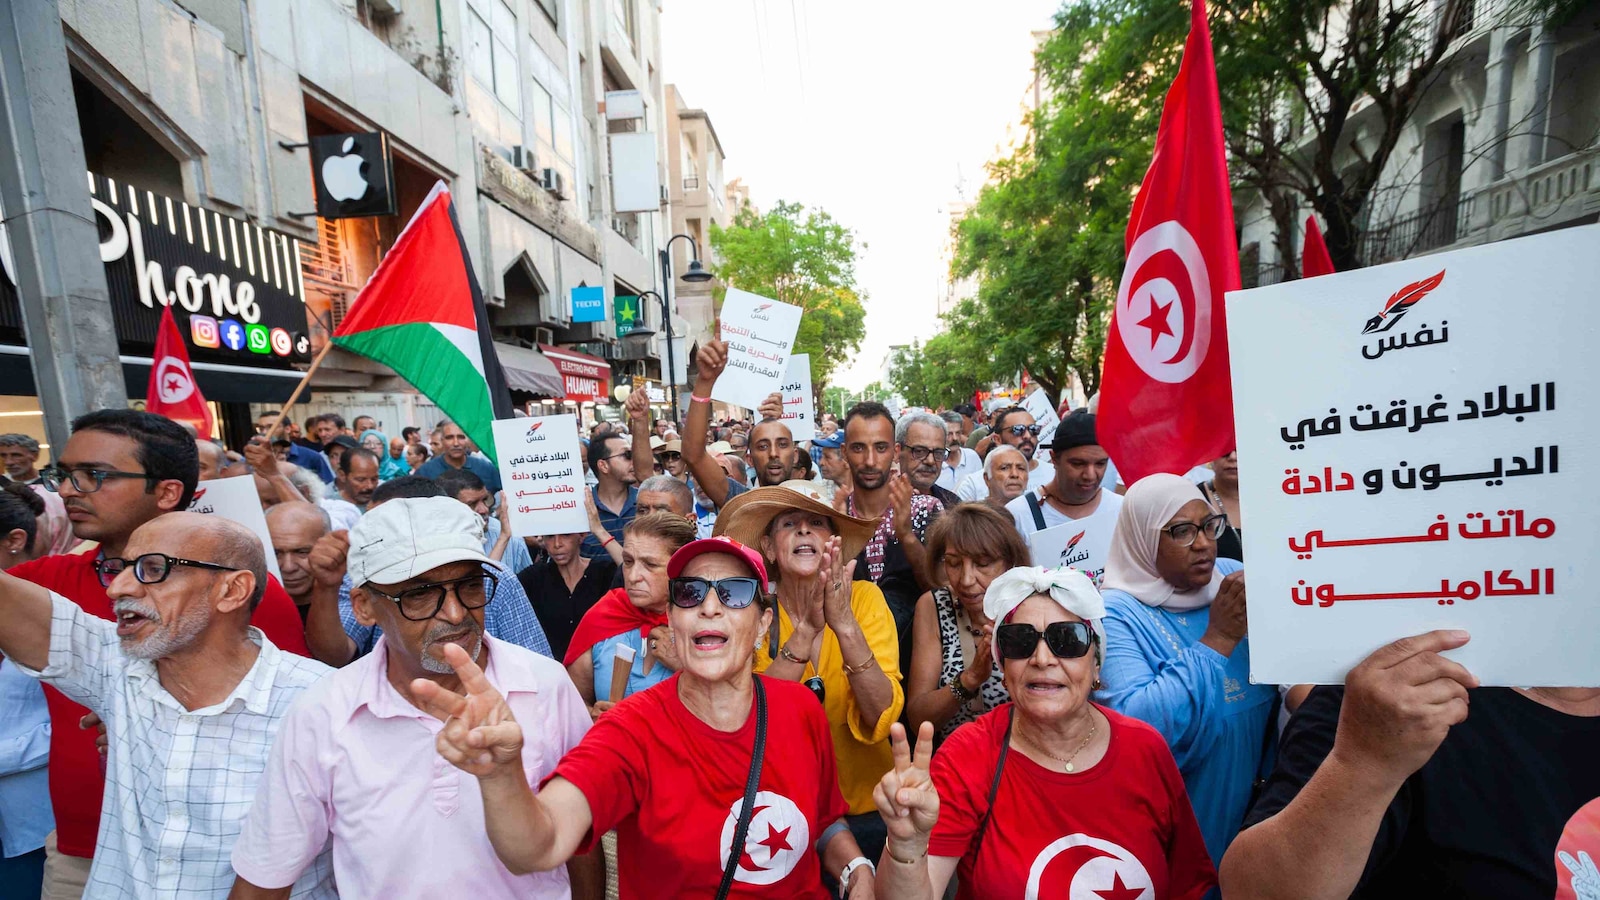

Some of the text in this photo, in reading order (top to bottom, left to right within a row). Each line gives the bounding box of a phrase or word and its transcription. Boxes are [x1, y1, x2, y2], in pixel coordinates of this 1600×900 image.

[574, 299, 601, 308] TECNO
[619, 325, 634, 333] STA
[721, 322, 750, 337] التنمية
[1361, 319, 1449, 359] نفس
[561, 361, 599, 376] ELECTRO PHONE
[566, 376, 600, 396] HUAWEI
[1280, 381, 1556, 451] البلاد غرقت في
[525, 433, 546, 443] نفس
[510, 451, 570, 467] البلاد غرقت في
[512, 471, 530, 481] دادة
[537, 468, 573, 479] الديون
[1281, 445, 1560, 495] الديون و دادة
[515, 485, 575, 499] ماتت في
[518, 500, 577, 513] الكاميون
[1288, 509, 1556, 560] ماتت في
[1290, 567, 1555, 608] الكاميون
